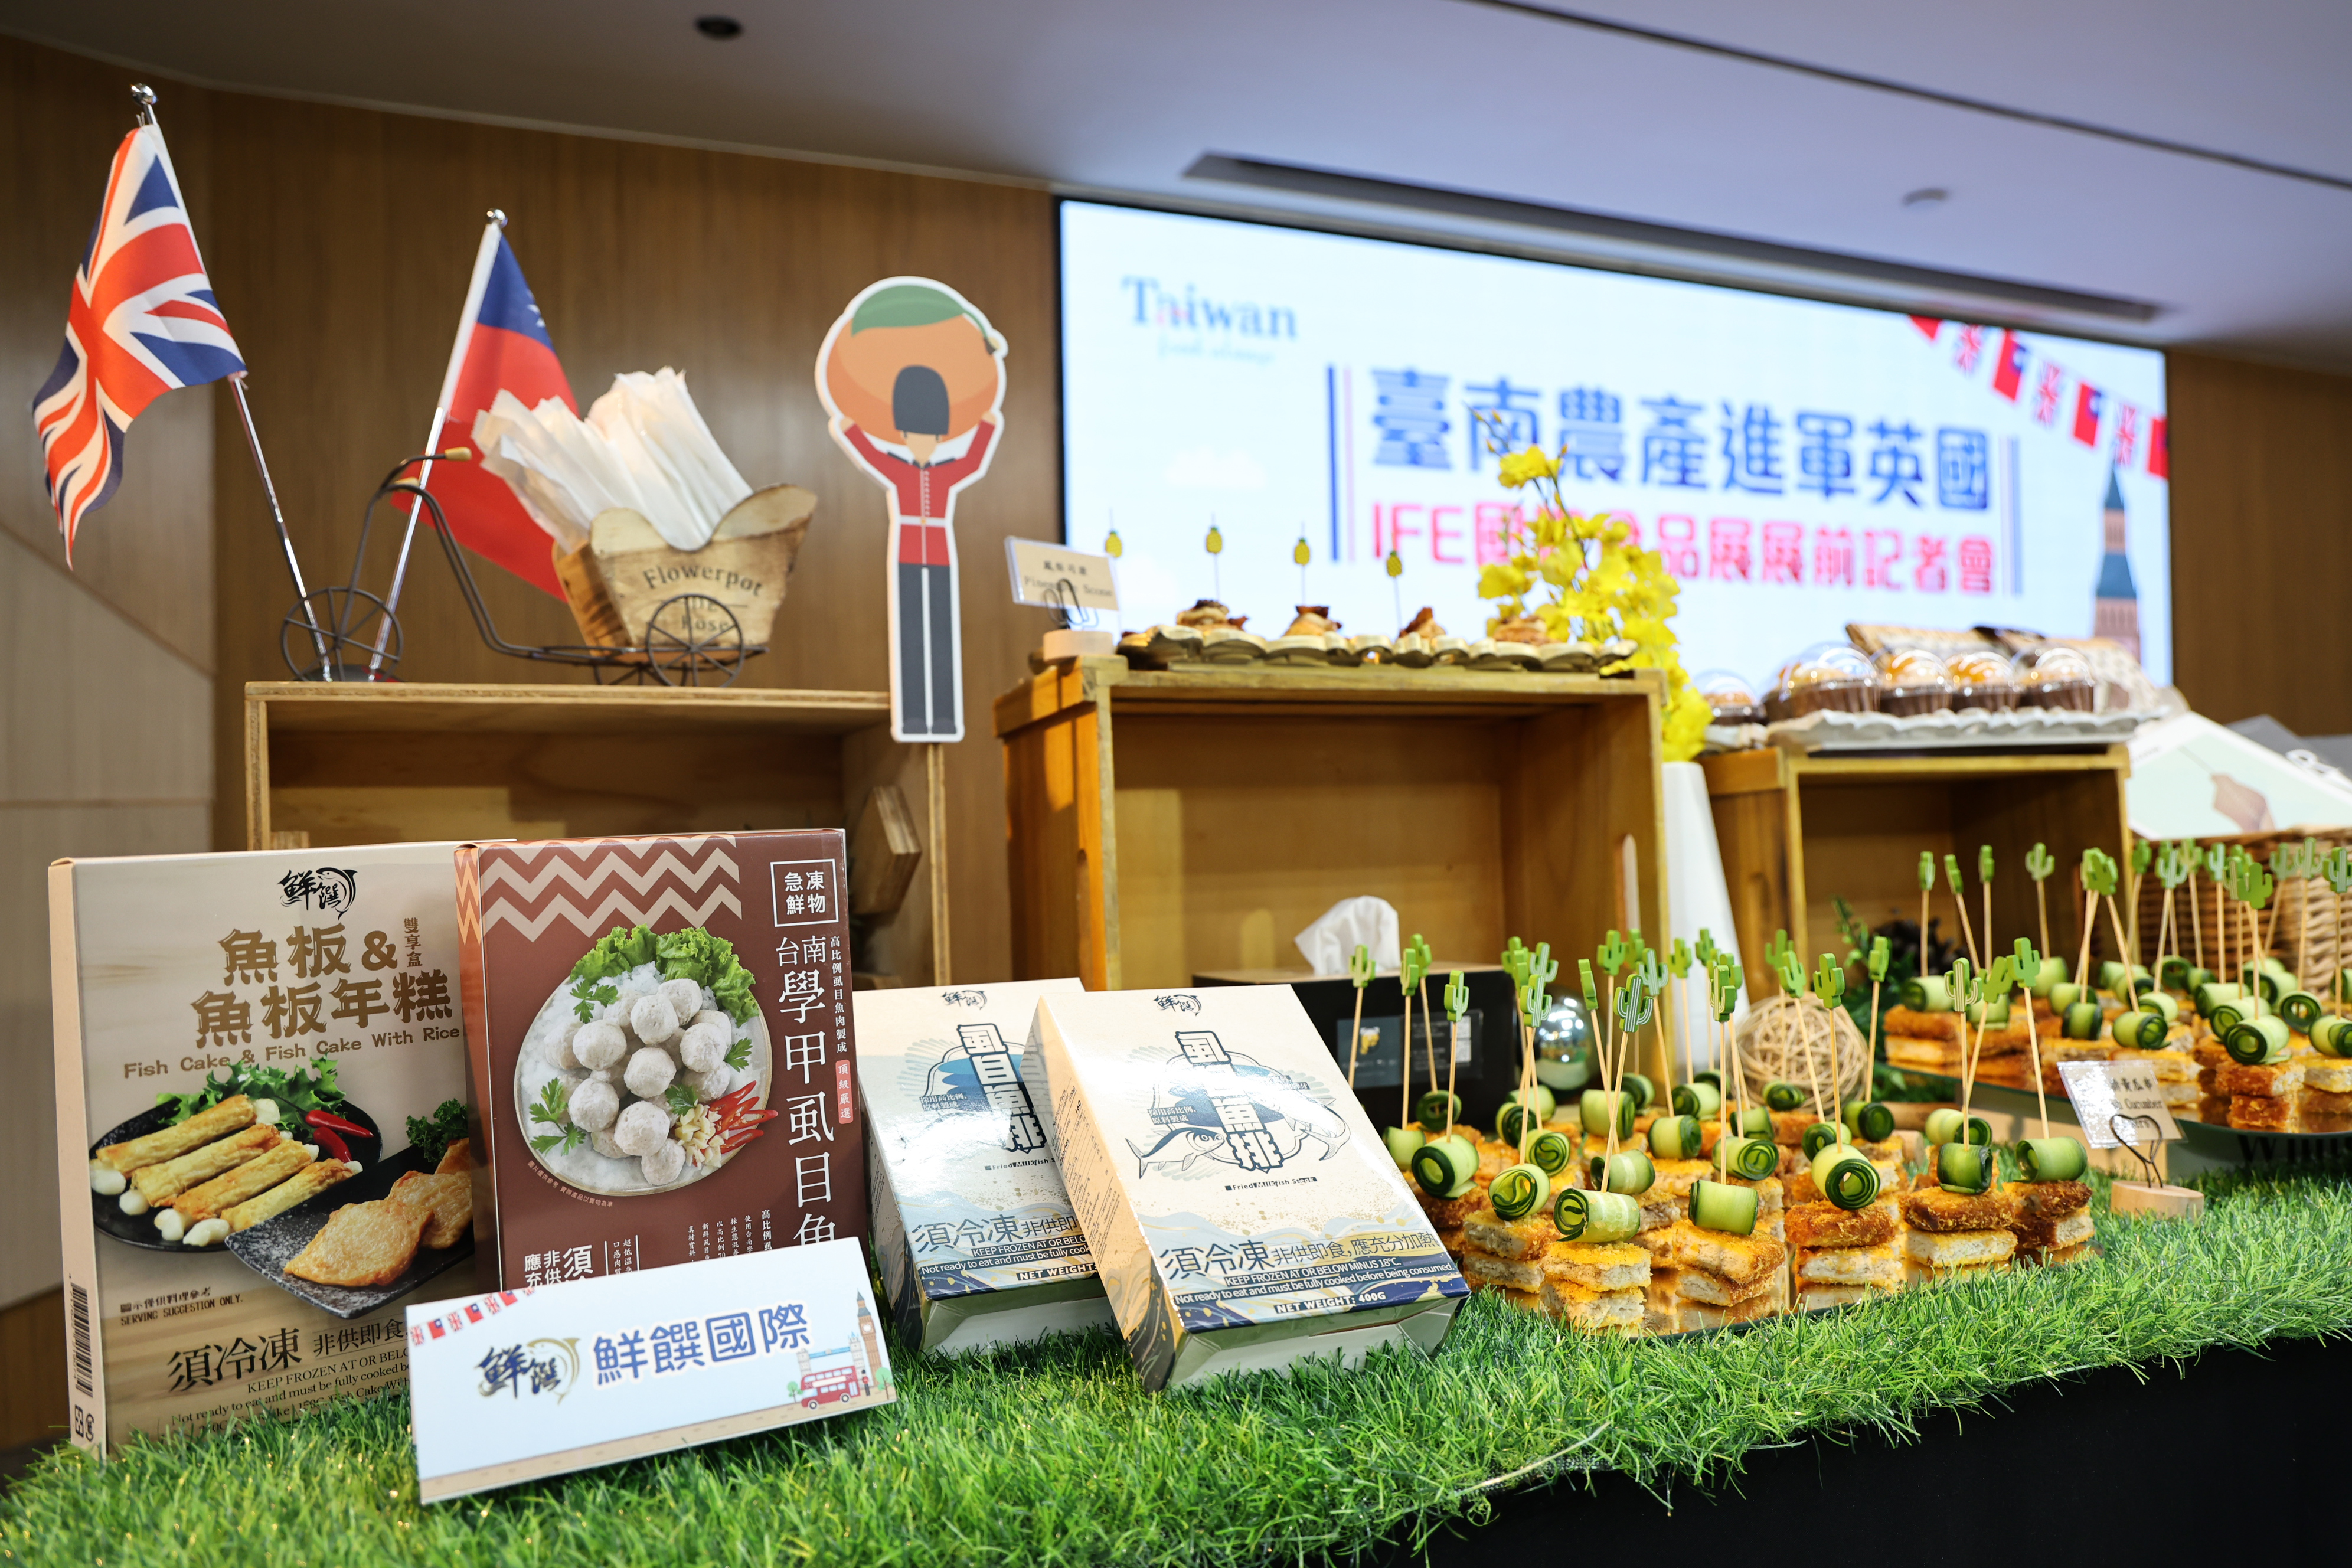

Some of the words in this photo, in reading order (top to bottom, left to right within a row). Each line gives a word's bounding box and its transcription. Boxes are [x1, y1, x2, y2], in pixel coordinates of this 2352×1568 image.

[1119, 275, 1298, 341] Taiwan
[1371, 365, 1988, 510] 臺南農產進軍英國
[1373, 502, 1992, 593] IFE國品展展前記者會
[643, 564, 763, 596] Flowerpot
[784, 870, 825, 891] 急凍
[786, 893, 826, 915] 鮮物
[219, 922, 398, 986] 魚板&
[403, 917, 423, 968] 雙享盒
[775, 935, 826, 967] 台南
[191, 969, 453, 1049] 魚板年糕
[829, 936, 847, 1054] 高比例虱目魚肉製成
[124, 1060, 168, 1079] Fish
[180, 1054, 230, 1072] Cake
[241, 1049, 255, 1063] &
[266, 1043, 306, 1061] Fish
[316, 1038, 362, 1055] Cake
[372, 1030, 413, 1048] With
[423, 1026, 460, 1041] Rice
[838, 1063, 851, 1119] 頂級嚴選
[1175, 1030, 1284, 1174] 虱魚排
[992, 1162, 1013, 1170] Fried
[1059, 1138, 1069, 1167] Calories
[912, 1214, 1023, 1253] 須冷凍
[1021, 1216, 1082, 1237] 非供即
[974, 1247, 998, 1257] KEEP
[998, 1243, 1035, 1253] FROZEN
[1037, 1241, 1047, 1250] AT
[1048, 1239, 1062, 1247] OR
[921, 1265, 939, 1275] Not
[940, 1260, 966, 1273] ready
[968, 1260, 977, 1269] to
[979, 1257, 993, 1266] eat
[994, 1256, 1011, 1265] and
[1013, 1253, 1036, 1263] must
[1038, 1250, 1048, 1259] be
[1048, 1247, 1069, 1259] fully
[1020, 1270, 1043, 1280] NET
[1046, 1263, 1097, 1277] WEIGHT:
[1159, 1240, 1275, 1280] 須冷凍
[1226, 1275, 1250, 1286] KEEP
[1252, 1271, 1291, 1283] FROZEN
[1290, 1270, 1301, 1279] AT
[1302, 1268, 1317, 1278] OR
[1318, 1263, 1349, 1275] BELOW
[1350, 1259, 1378, 1270] MINUS
[1175, 1295, 1194, 1304] Not
[1195, 1291, 1221, 1302] ready
[1223, 1290, 1233, 1298] to
[1233, 1288, 1249, 1297] eat
[1249, 1286, 1267, 1295] and
[1269, 1283, 1292, 1293] must
[1292, 1281, 1304, 1290] be
[1305, 1277, 1324, 1289] fully
[1324, 1272, 1357, 1286] cooked
[1357, 1269, 1384, 1281] before
[1385, 1266, 1407, 1278] being
[1407, 1262, 1455, 1276] consumed.
[1276, 1304, 1301, 1314] NET
[1304, 1296, 1356, 1309] WEIGHT:
[1358, 1292, 1386, 1302] 400G
[120, 1310, 158, 1326] SERVING
[163, 1298, 215, 1318] SUGGESTION
[220, 1293, 243, 1306] ONLY.
[167, 1327, 302, 1392] 須冷凍
[594, 1304, 810, 1386] 鮮饌國際
[196, 1403, 228, 1419] ready
[232, 1401, 243, 1411] to
[246, 1398, 260, 1408] eat
[264, 1391, 286, 1404] and
[289, 1384, 316, 1399] must
[319, 1381, 332, 1390] be
[334, 1375, 359, 1386] fully
[361, 1364, 398, 1381] cooked
[247, 1376, 283, 1393] KEEP
[286, 1364, 337, 1386] FROZEN
[339, 1359, 357, 1373] AT
[359, 1355, 377, 1367] OR
